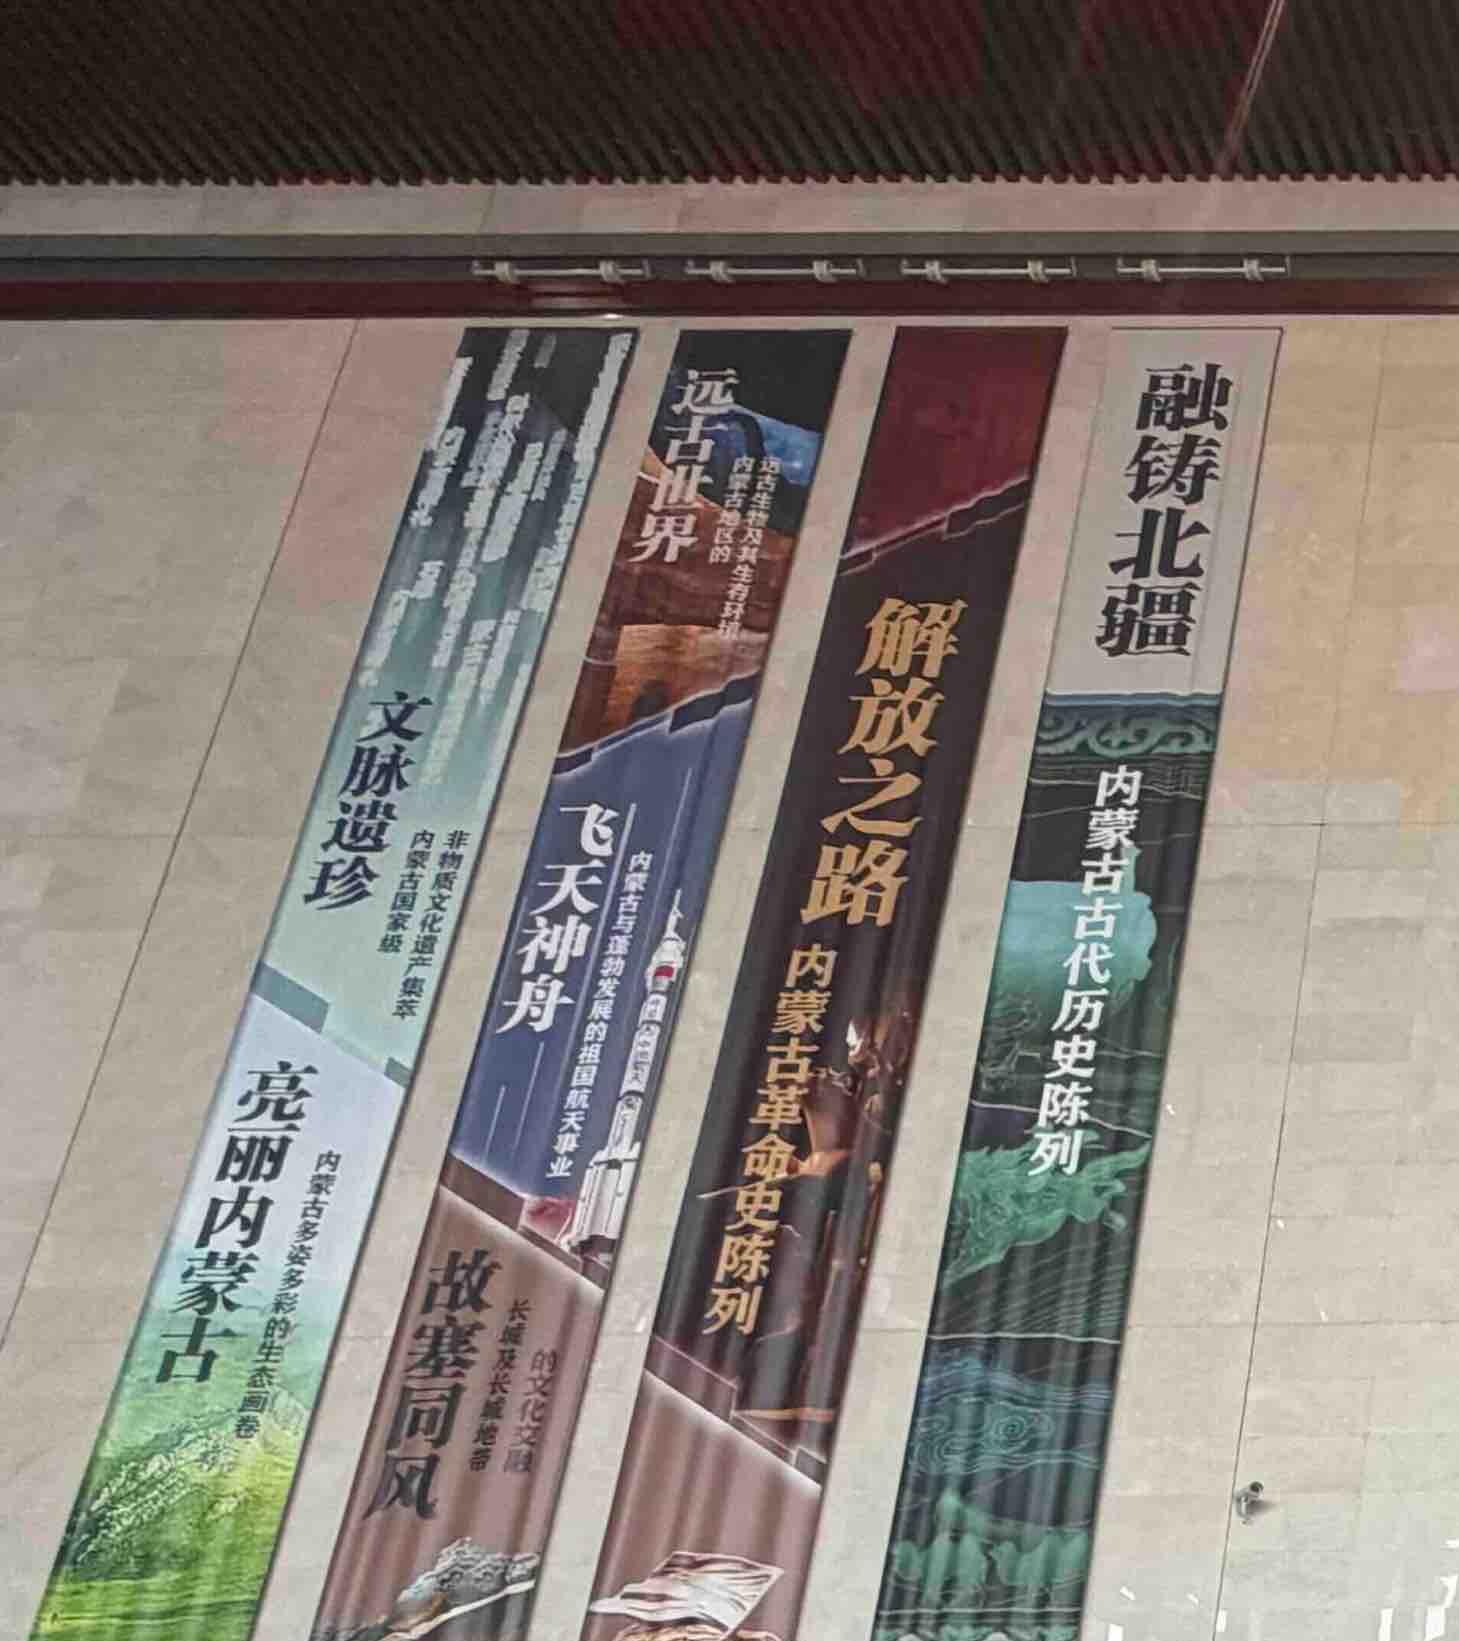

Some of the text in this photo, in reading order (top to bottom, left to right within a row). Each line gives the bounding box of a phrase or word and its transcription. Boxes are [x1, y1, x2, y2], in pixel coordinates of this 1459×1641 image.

[628, 368, 739, 563] 远古世界
[1095, 362, 1234, 658] 融铸北疆
[303, 691, 433, 910] 文脉遗珍
[377, 830, 435, 953] 内蒙古国家级
[800, 597, 968, 928] 解放之路
[495, 802, 619, 1034] 飞天神舟
[1028, 764, 1144, 1177] 内蒙古古代历史陈列
[156, 1060, 319, 1384] 亮丽内蒙古
[701, 943, 837, 1336] 内蒙古革命史陈列
[363, 1247, 501, 1520] 故塞同风
